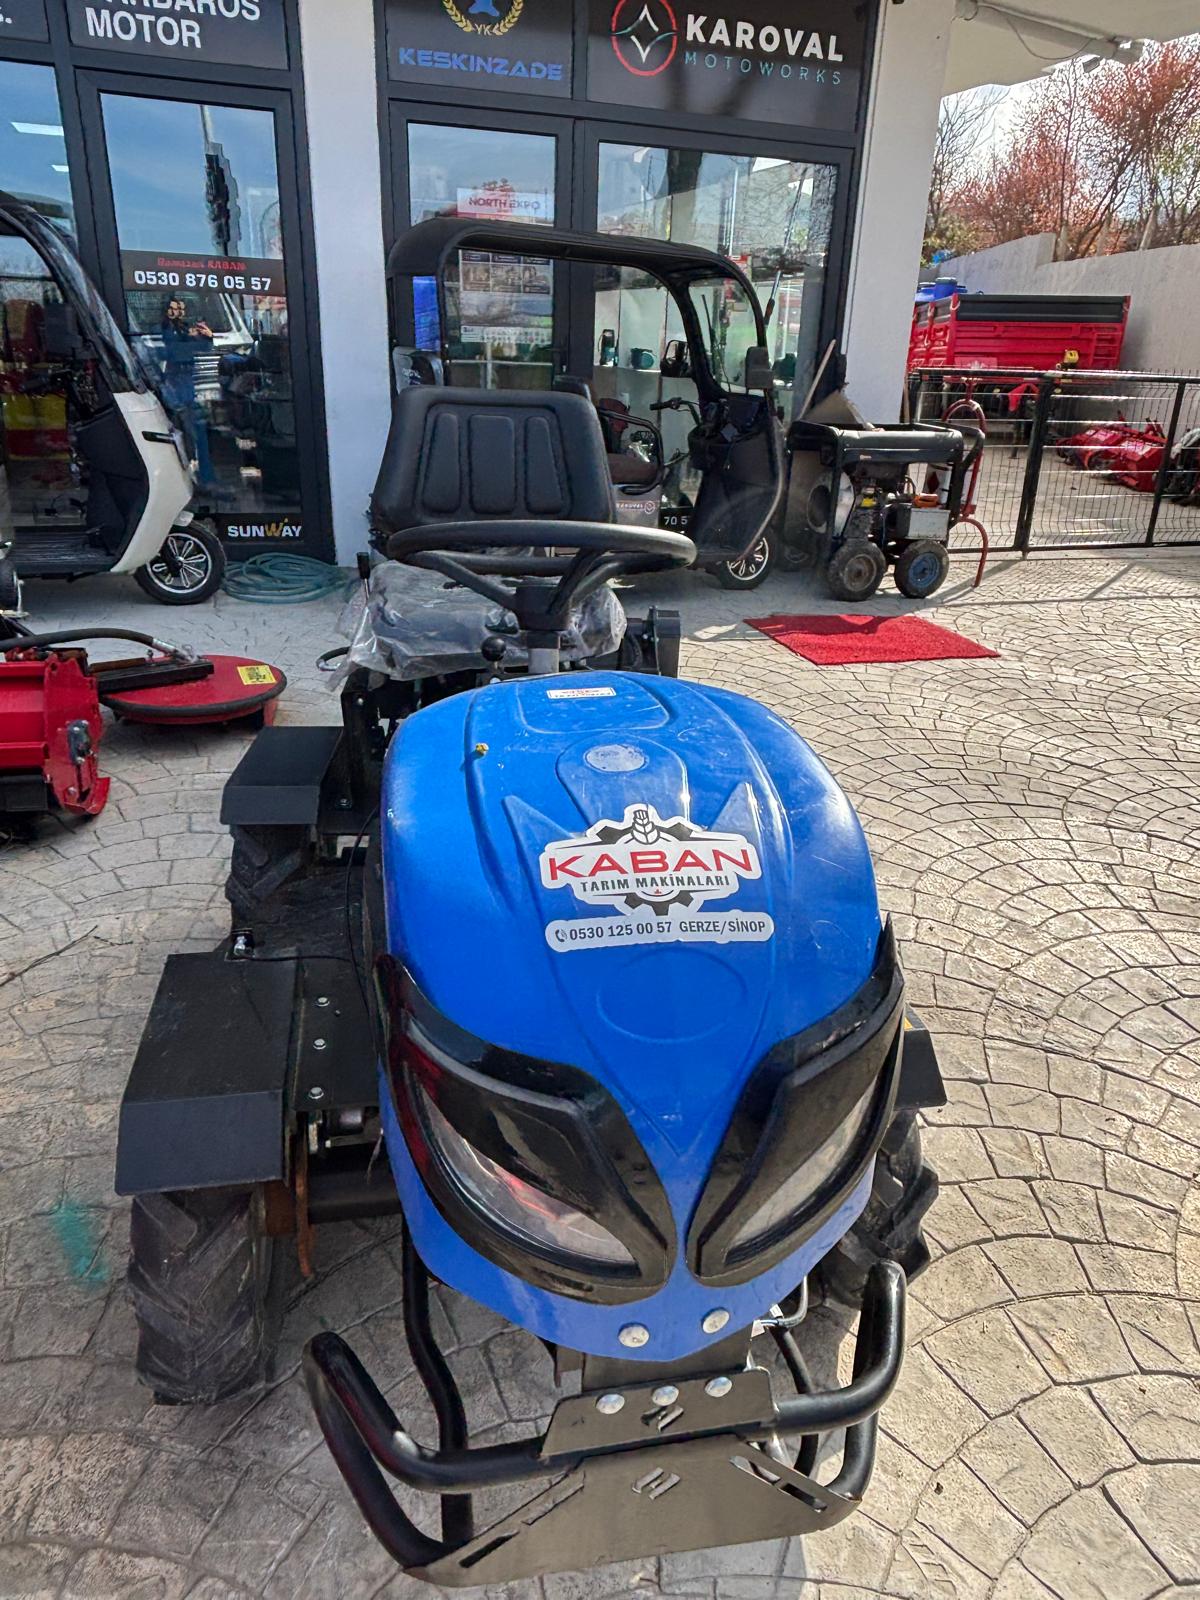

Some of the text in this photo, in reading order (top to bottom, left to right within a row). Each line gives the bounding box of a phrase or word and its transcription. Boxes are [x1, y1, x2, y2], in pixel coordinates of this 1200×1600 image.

[85, 7, 202, 48] MOTOR
[686, 13, 844, 62] KAROVAL
[398, 47, 564, 81] KESKINZADE
[684, 51, 842, 85] MOTOWORKS
[468, 197, 541, 210] NORTH EXPO
[134, 270, 272, 291] 0530 876 05 57
[227, 519, 302, 537] SUNWAY
[664, 516, 678, 525] 70
[549, 849, 753, 881] KABAN
[580, 873, 730, 893] TARIM MAKİNALARI
[569, 918, 766, 940] 0530 125 00 57 GERZE/SİNOP
